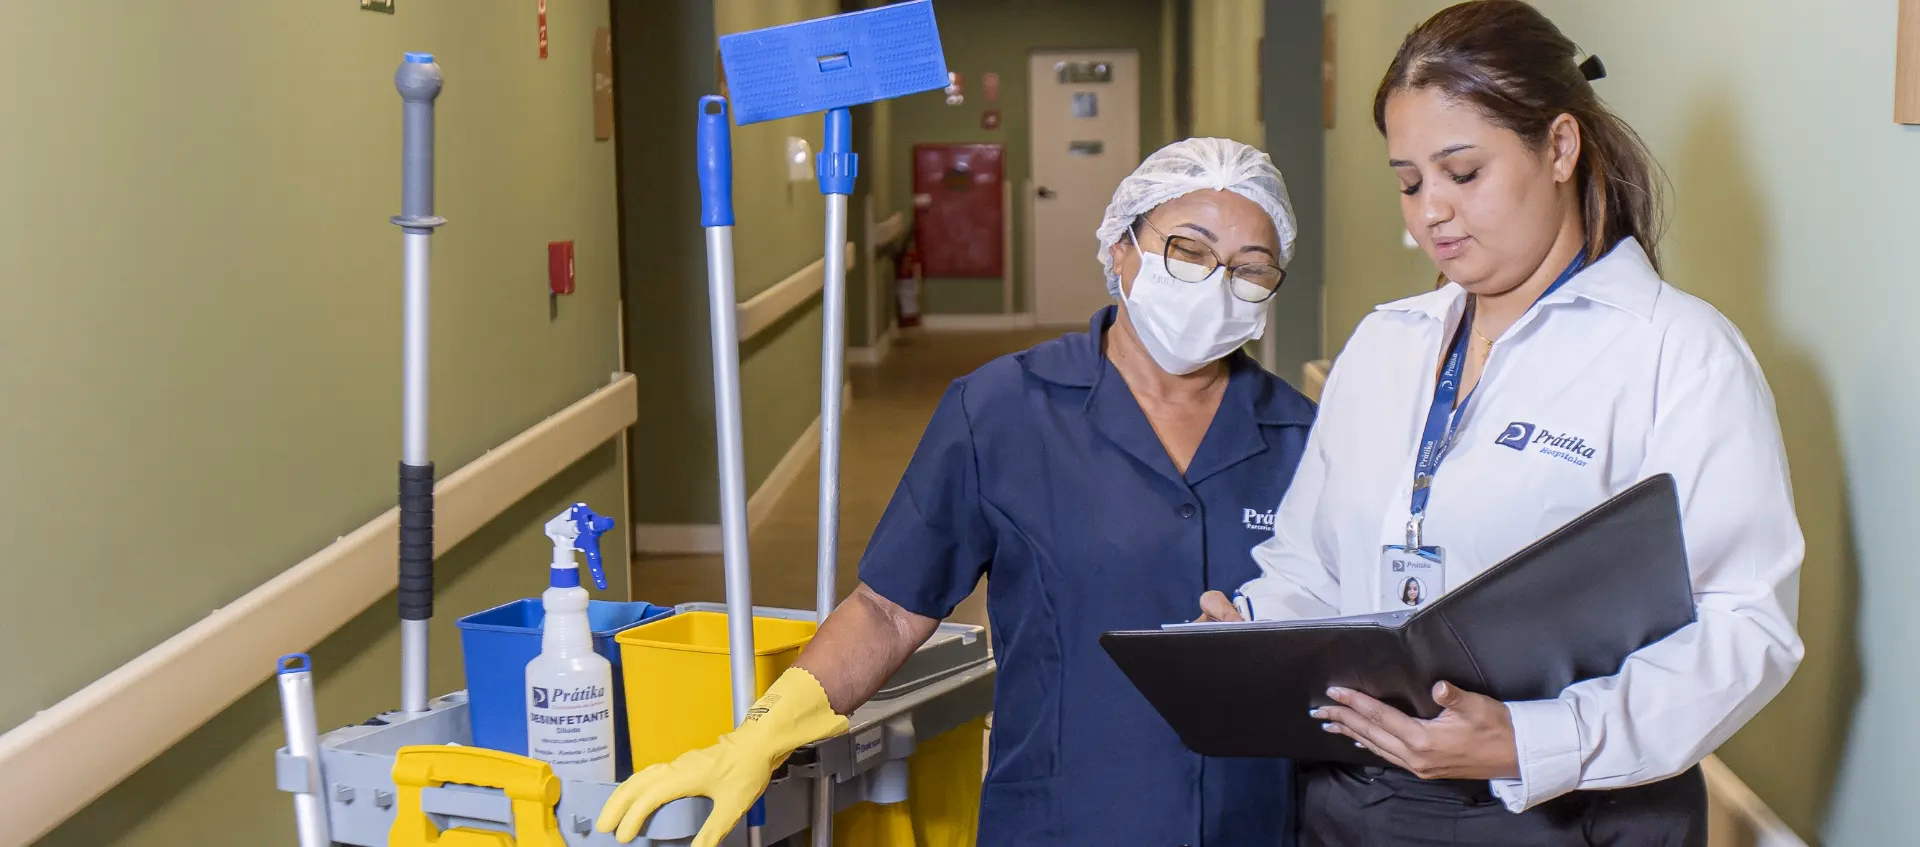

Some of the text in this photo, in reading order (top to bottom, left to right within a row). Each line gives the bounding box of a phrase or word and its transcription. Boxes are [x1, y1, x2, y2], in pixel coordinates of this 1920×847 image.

[1532, 429, 1596, 459] Prátika
[1419, 440, 1434, 468] Prátika
[1539, 446, 1588, 467] Hospitalar
[1242, 507, 1276, 525] Prá
[551, 685, 605, 703] Prátika
[530, 708, 610, 725] DESINFETANTE
